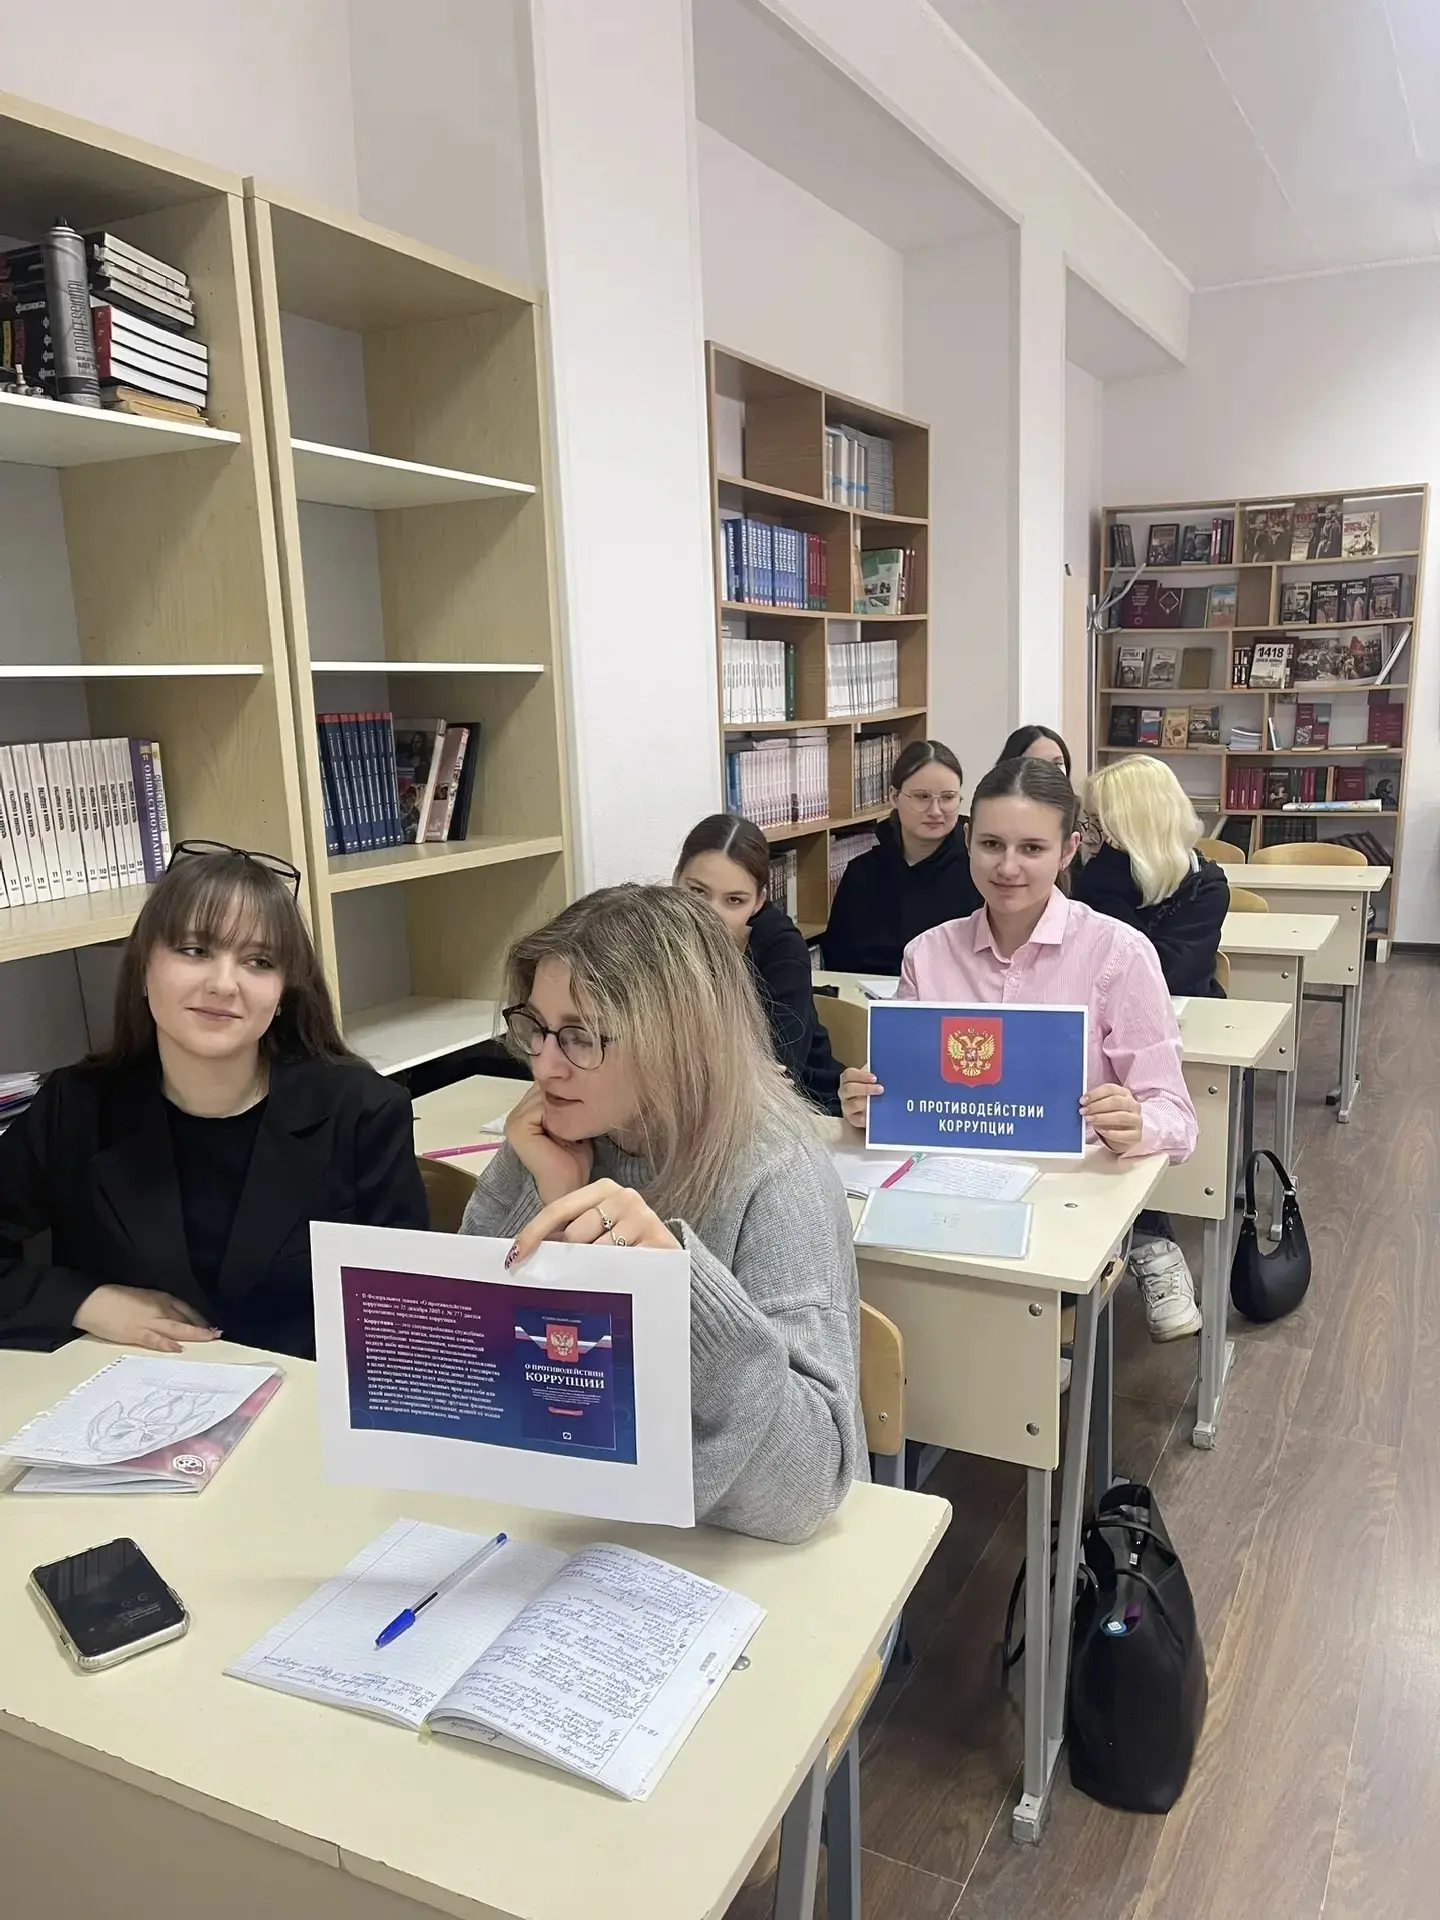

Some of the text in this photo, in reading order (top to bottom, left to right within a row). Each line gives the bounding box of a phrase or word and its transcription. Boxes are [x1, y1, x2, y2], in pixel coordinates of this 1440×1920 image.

[144, 764, 162, 872] ОБЩЕСТВОЗНАНИЕ
[906, 1099, 1044, 1119] О ПРОТИВОДЕЙСТВИИ
[939, 1119, 1014, 1137] КОРРУПЦИИ
[532, 1364, 604, 1378] ПРОТИВОДЕЙСТВИИ
[525, 1372, 605, 1389] КОРРУПЦИИ
